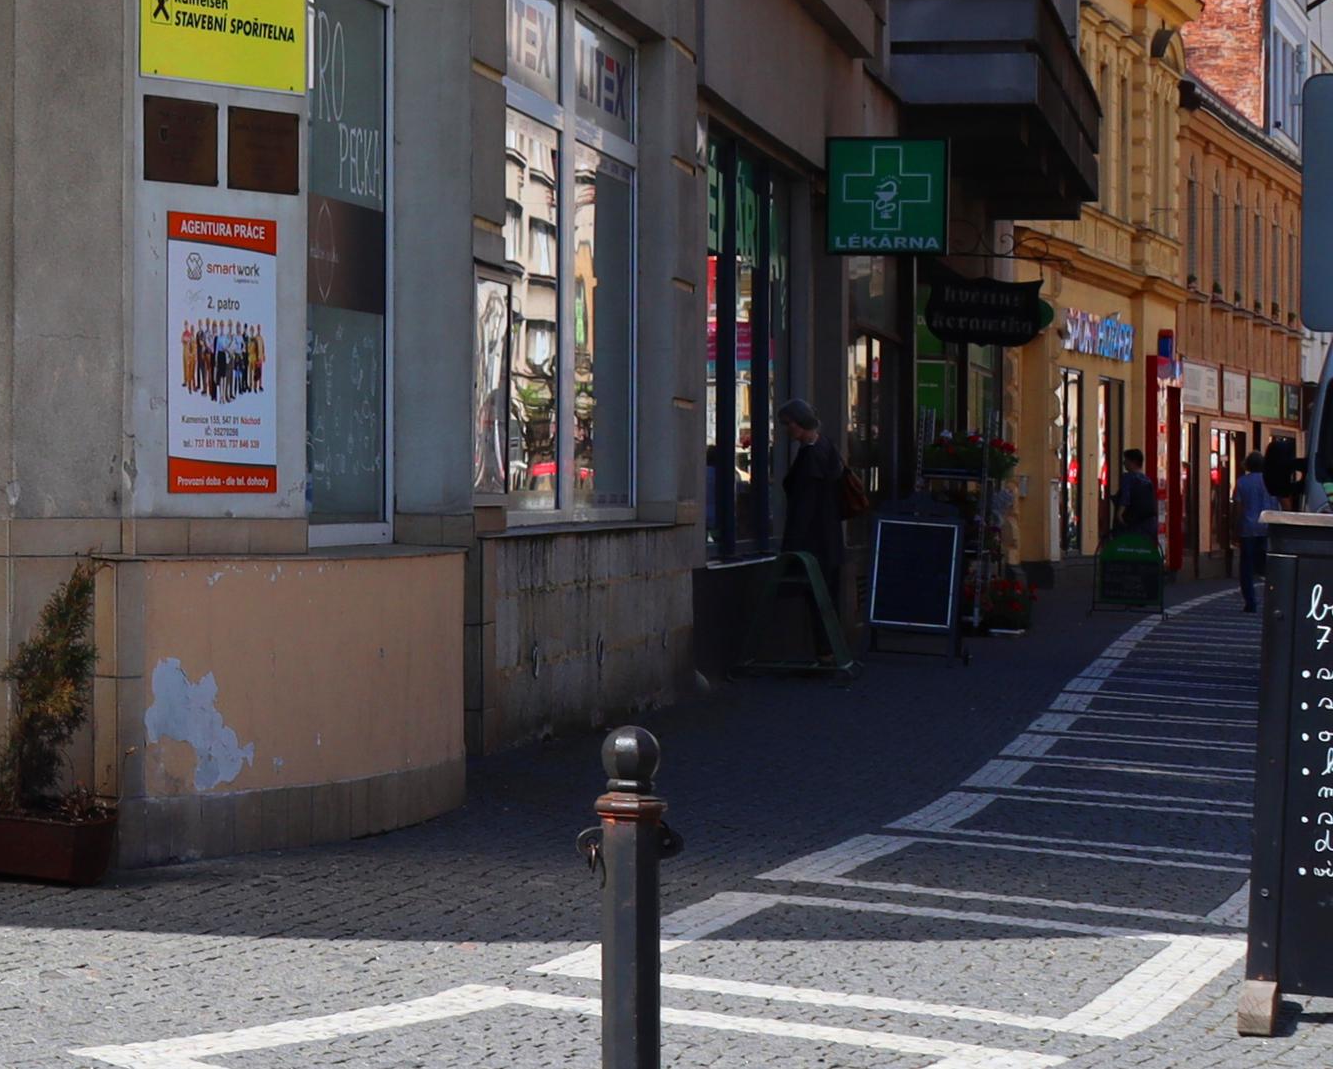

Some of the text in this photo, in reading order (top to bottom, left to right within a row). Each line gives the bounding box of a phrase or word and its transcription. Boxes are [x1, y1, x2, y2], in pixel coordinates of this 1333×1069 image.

[174, 10, 295, 43] STAVEBNÍ SPOŘITELNA
[578, 39, 626, 121] LITEX
[180, 219, 265, 240] AGENTURA PRÁCE
[835, 233, 939, 249] LÉKÁRNA
[206, 263, 260, 277] smartwork
[207, 295, 240, 312] 2. patro
